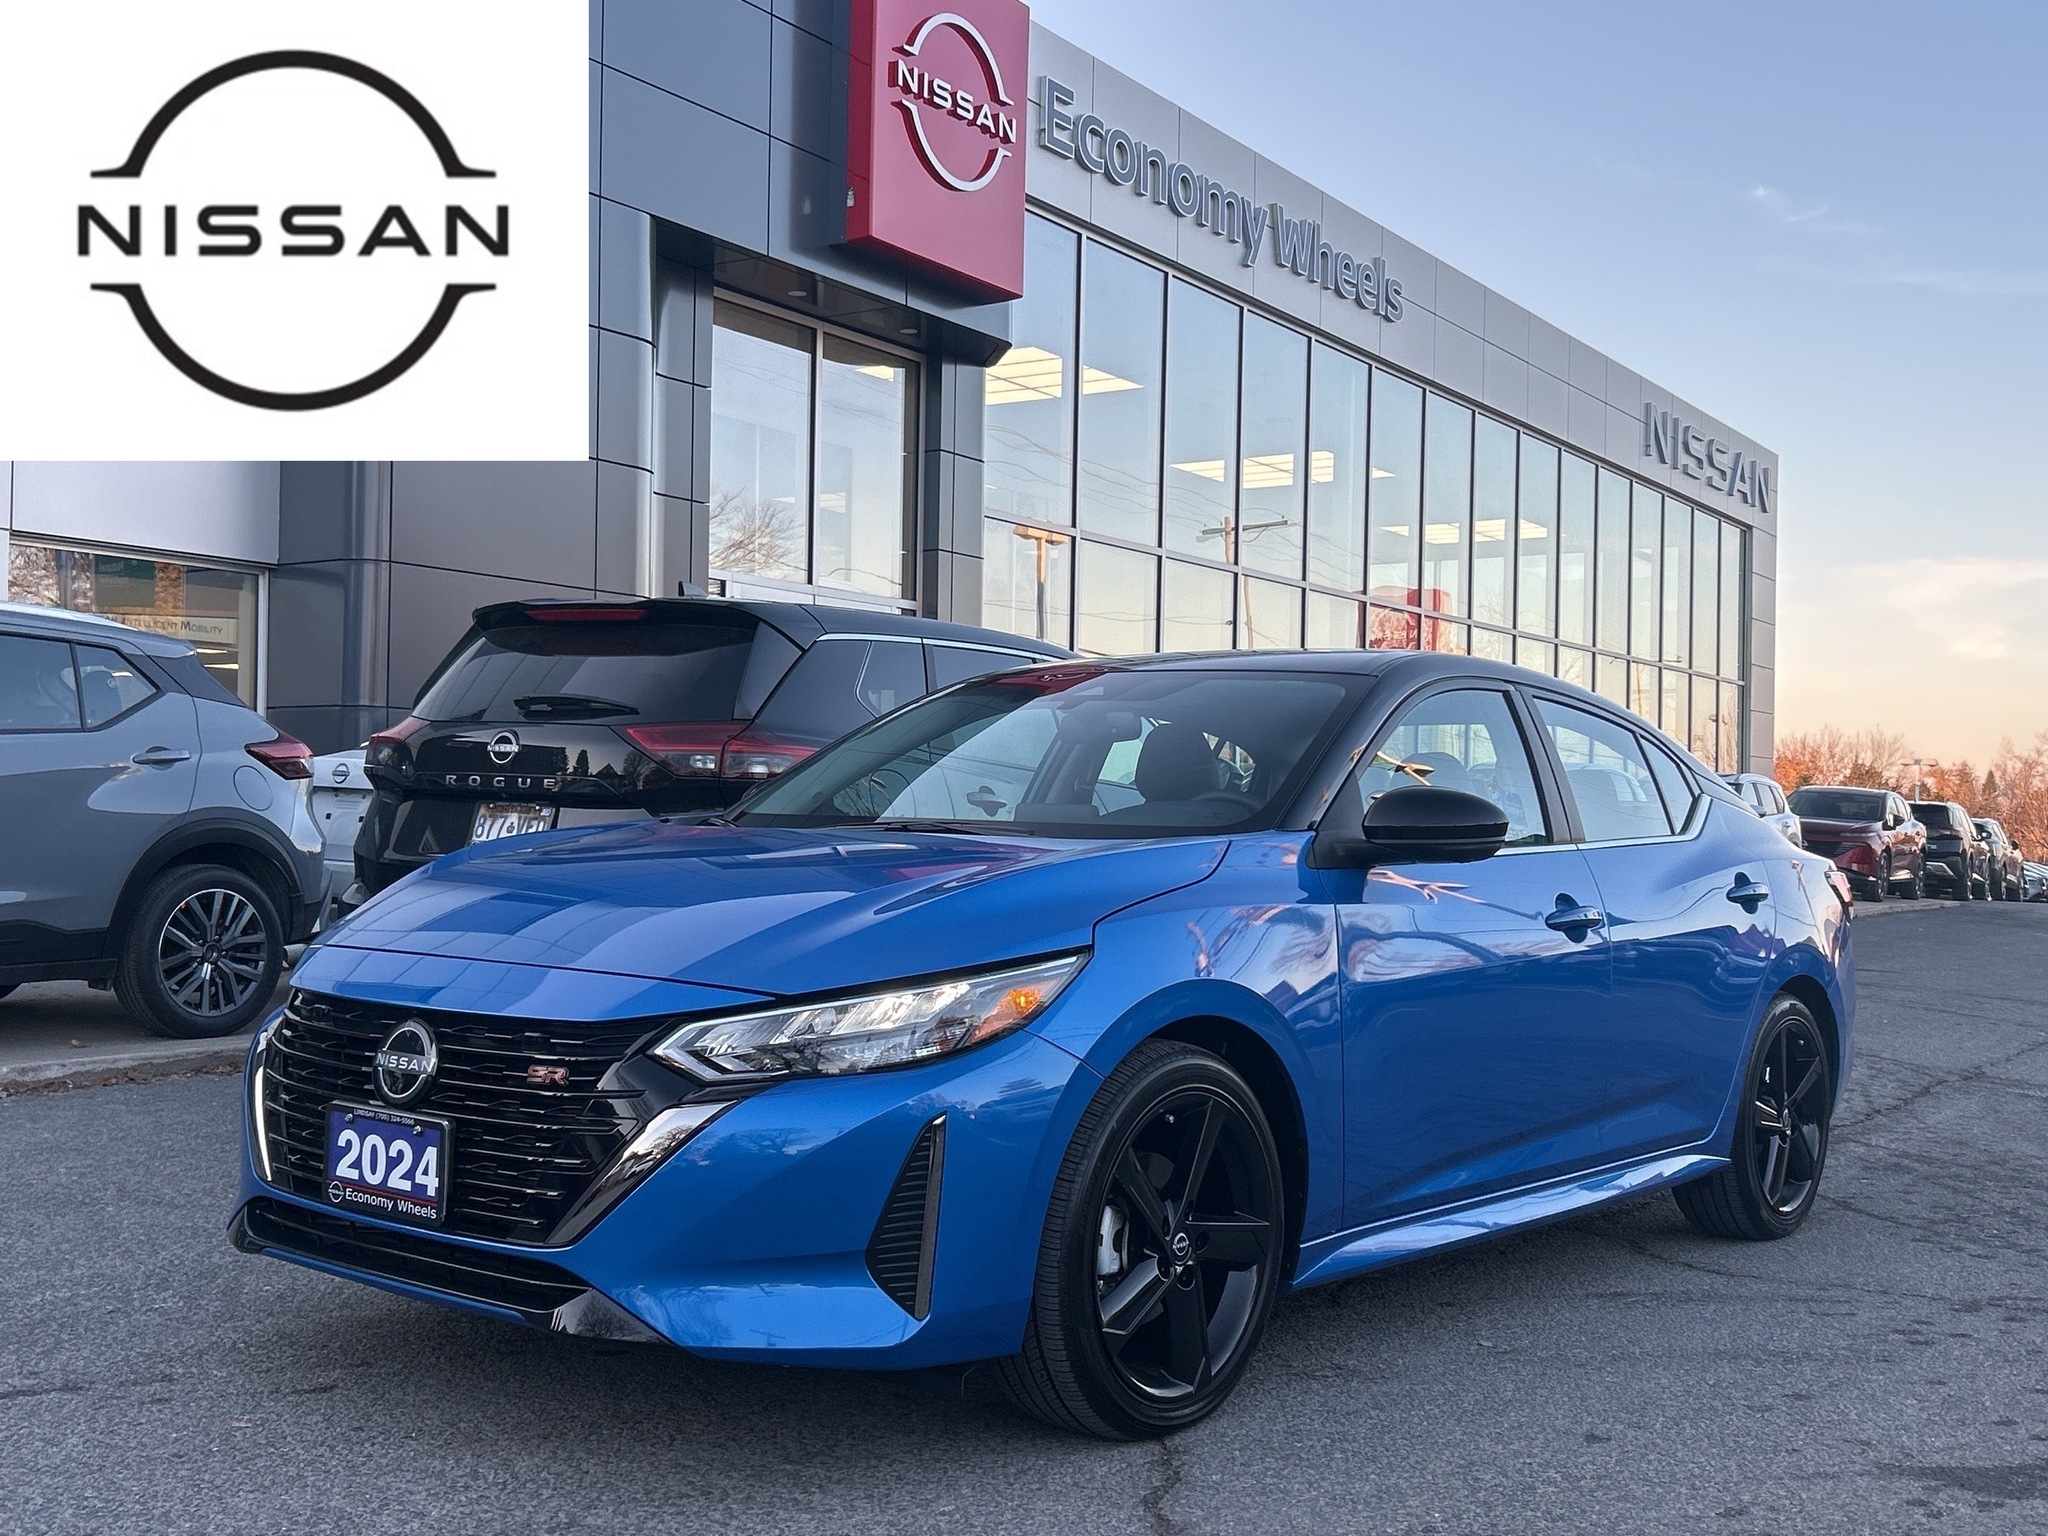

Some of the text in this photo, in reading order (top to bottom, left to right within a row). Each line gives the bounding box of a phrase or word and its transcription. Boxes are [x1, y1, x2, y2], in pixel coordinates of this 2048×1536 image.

[892, 58, 1017, 144] NISSAN
[1039, 75, 1405, 323] Economy Wheels
[1644, 401, 1772, 514] NISSAN
[180, 620, 223, 634] MOBILITY
[487, 744, 519, 752] NISSAN
[445, 775, 556, 788] ROGUE
[375, 1052, 436, 1073] NISSAN
[527, 1064, 569, 1086] SR
[336, 1129, 439, 1197] 2024
[345, 1188, 437, 1219] Economy Wheels
